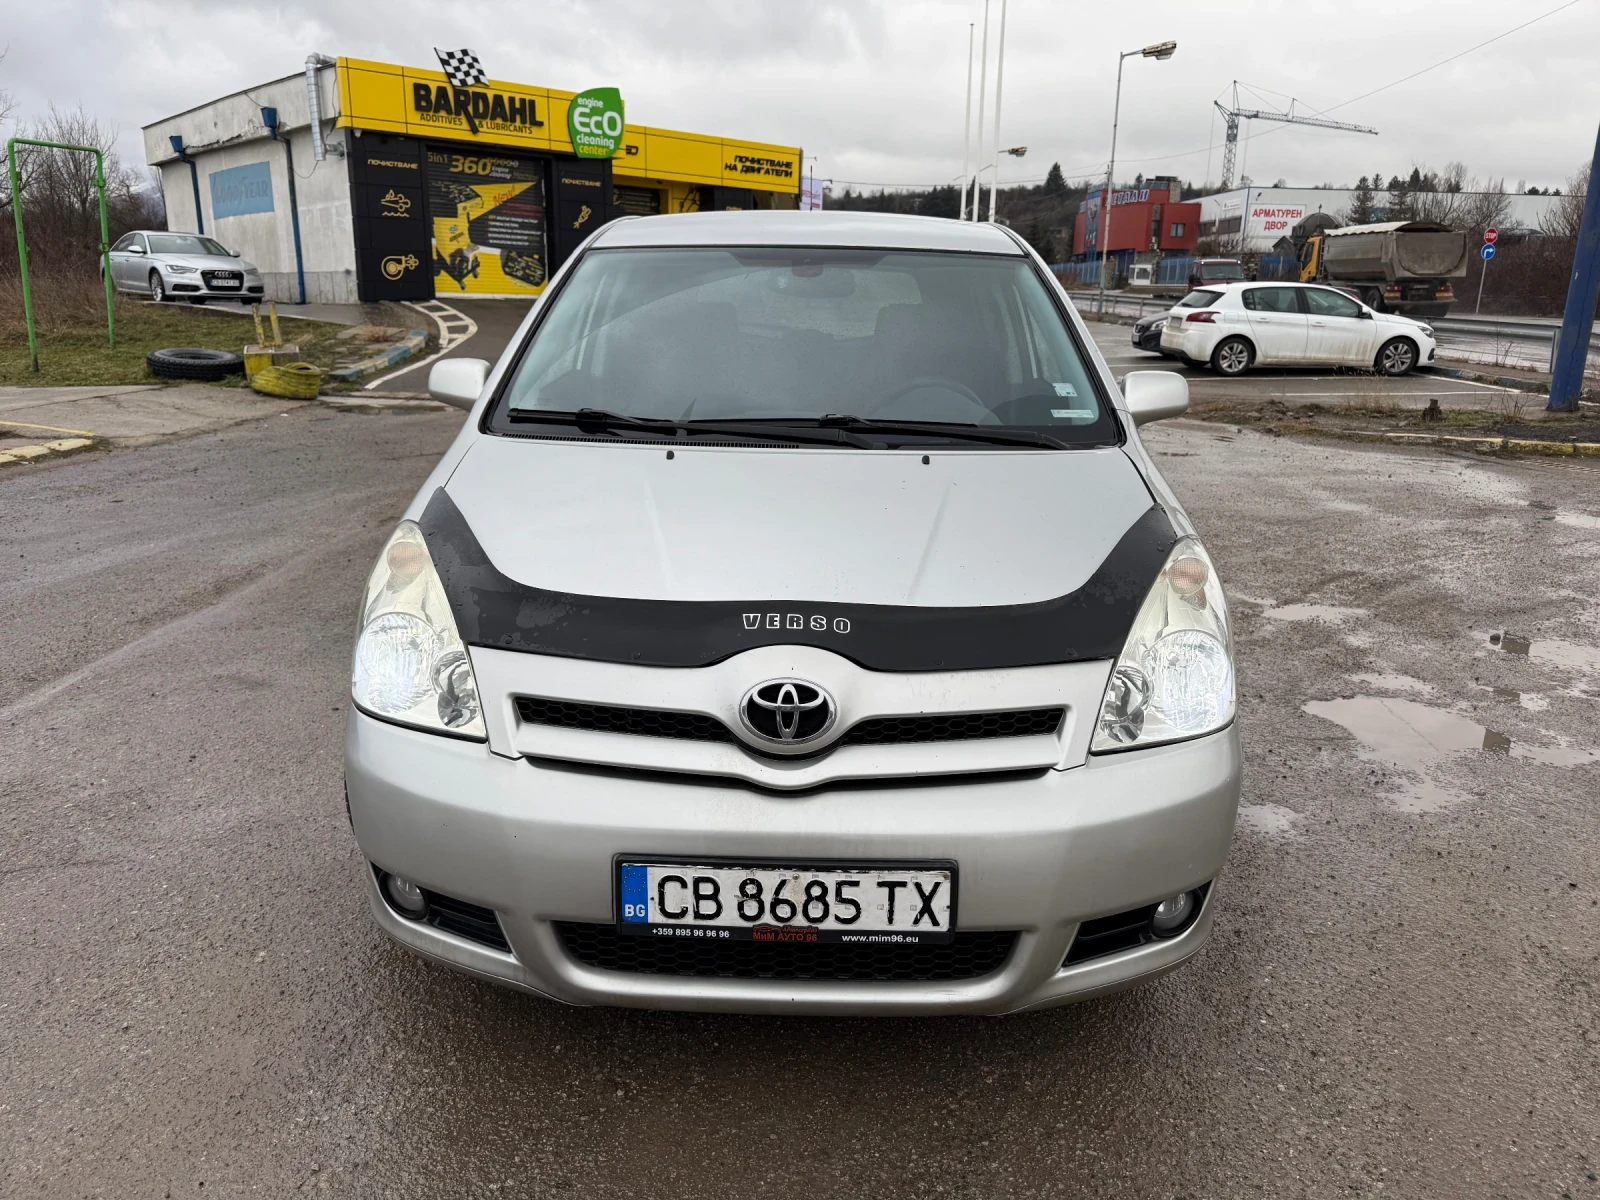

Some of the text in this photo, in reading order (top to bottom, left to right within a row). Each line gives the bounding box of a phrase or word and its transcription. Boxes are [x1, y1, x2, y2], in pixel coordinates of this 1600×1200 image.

[413, 82, 544, 134] BARDAHL
[577, 97, 604, 108] engine
[420, 113, 533, 135] ADDITIVES & LUBRICANTS
[576, 133, 614, 150] cleaning
[579, 145, 608, 156] center
[367, 158, 419, 169] ПОЧИСТВАНЕ
[449, 155, 492, 176] 360
[734, 155, 793, 169] ПОЧИСТВАНЕ
[724, 163, 793, 178] НА ДВИГАТЕЛИ
[561, 178, 602, 187] ПОЧИСТВАНЕ
[1252, 208, 1303, 219] АРМАТУРЕН
[1263, 221, 1288, 231] ДВОР
[1485, 232, 1498, 240] STOP
[742, 613, 851, 634] VERSO
[657, 874, 943, 927] CB 8685 TX
[624, 904, 646, 917] BG
[652, 927, 730, 938] +359 895 96 96 96
[806, 934, 818, 942] 96
[841, 934, 919, 943] www.mim96.eu
